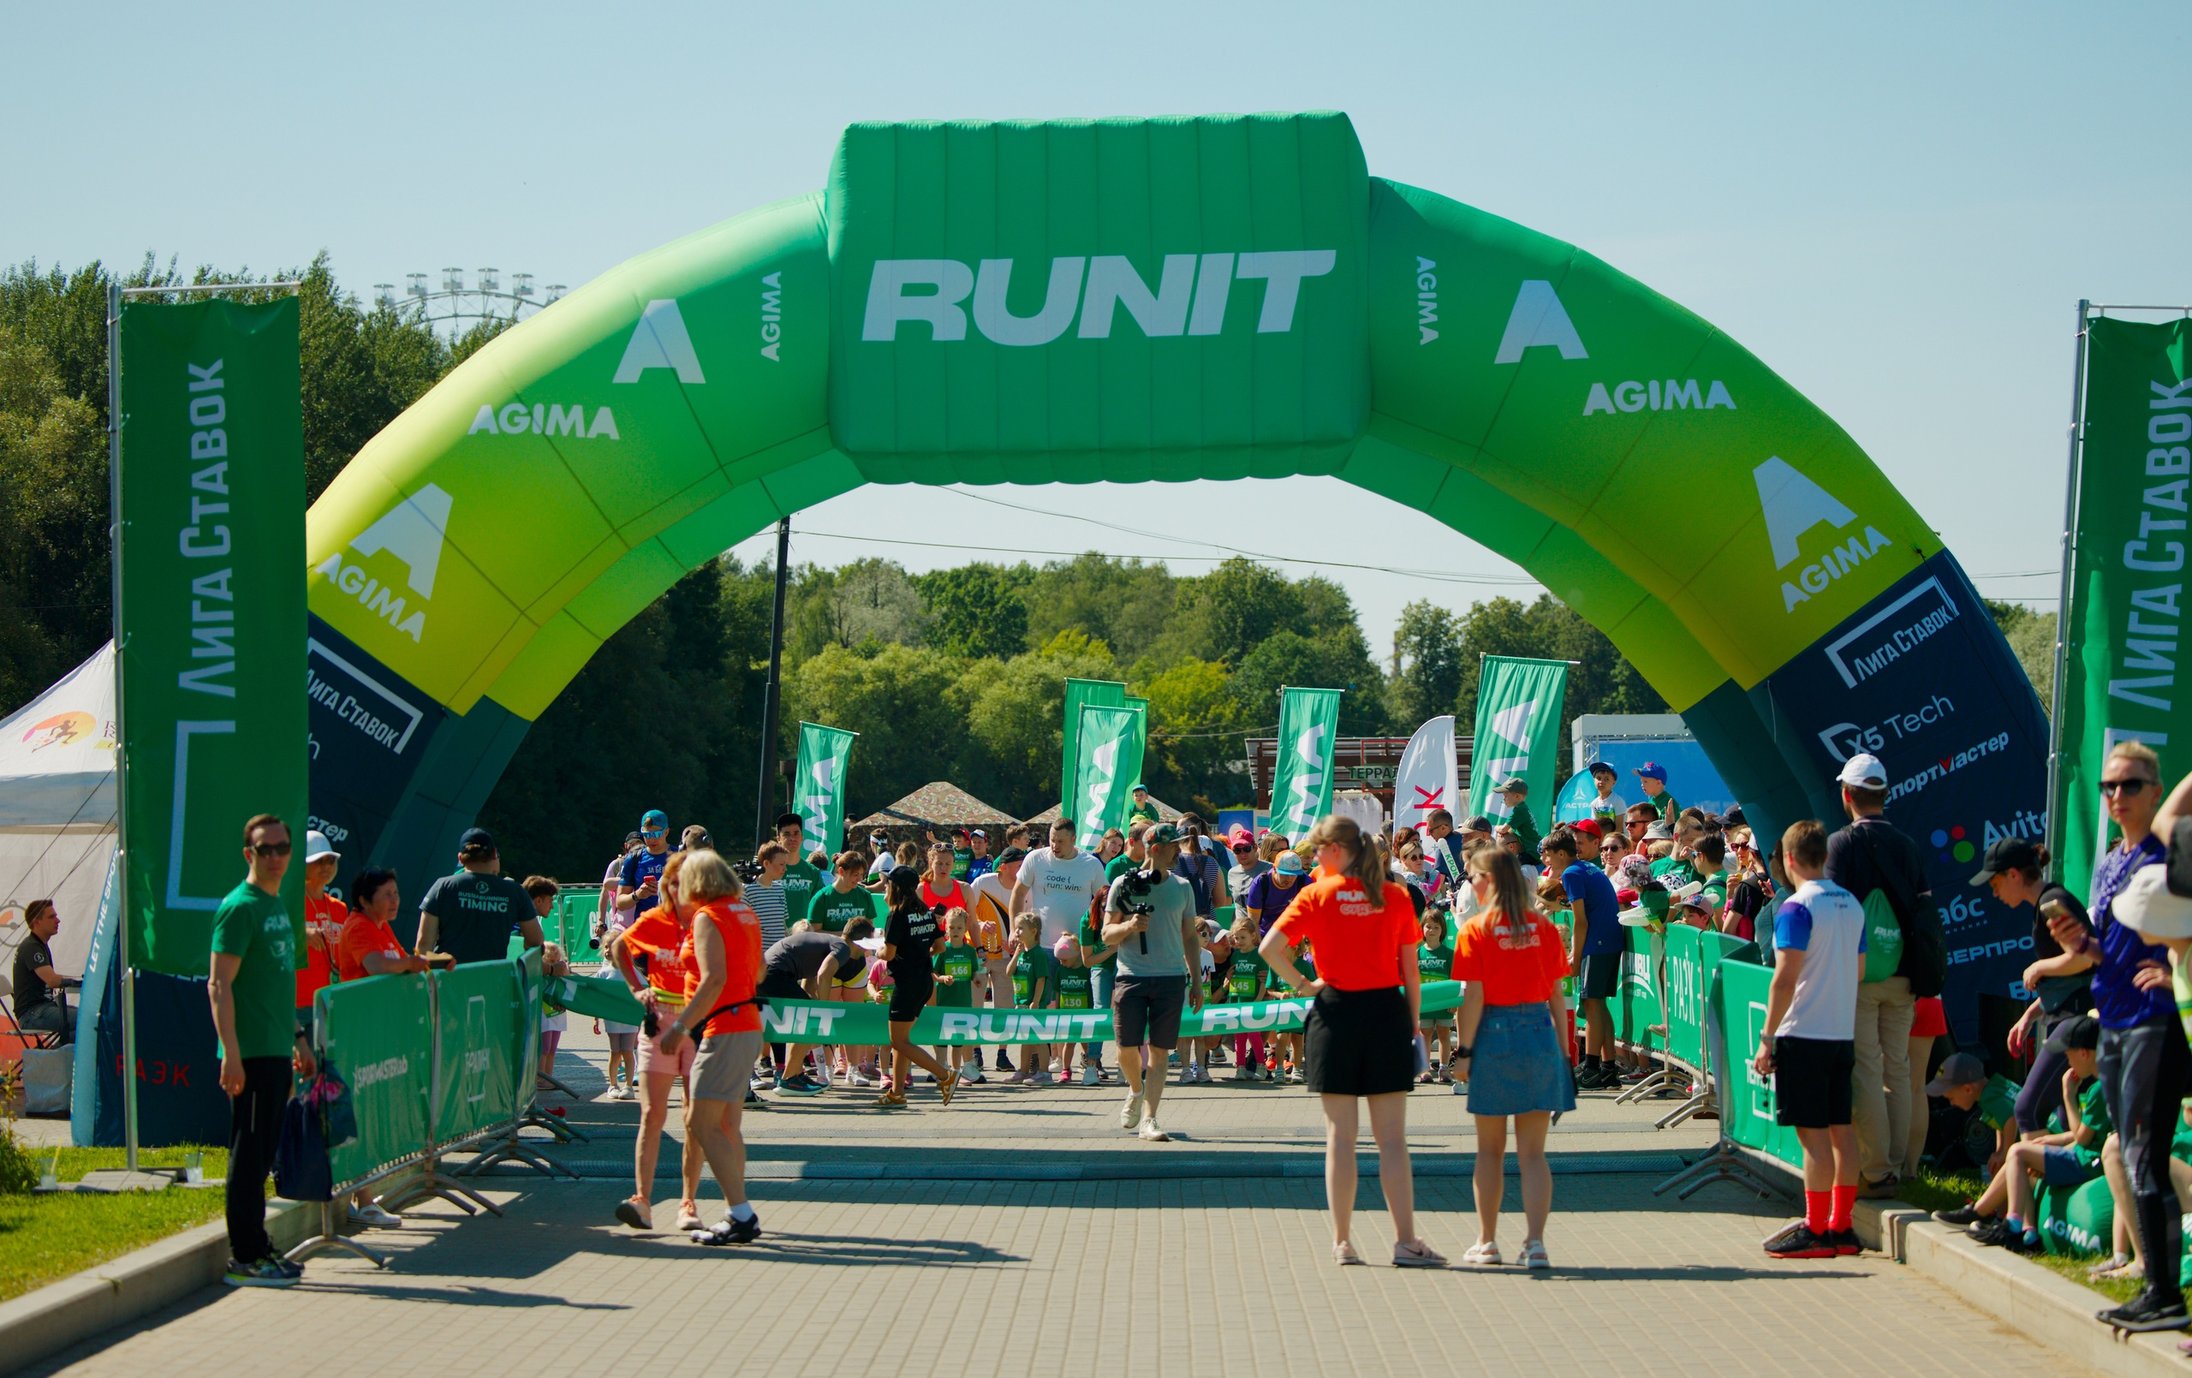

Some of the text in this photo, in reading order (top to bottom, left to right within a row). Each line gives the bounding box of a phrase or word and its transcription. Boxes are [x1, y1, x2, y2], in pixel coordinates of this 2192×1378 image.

[760, 271, 781, 362] AGIMA
[862, 249, 1336, 347] RUNIT
[1416, 255, 1439, 346] AGIMA
[1582, 379, 1736, 416] AGIMA
[467, 403, 620, 440] AGIMA
[1780, 525, 1893, 615] AGIMA
[315, 552, 426, 644] AGIMA
[1883, 694, 1955, 739] Tech
[1046, 874, 1066, 882] code
[458, 898, 508, 913] TIMING
[827, 908, 865, 918] RUNIT
[89, 937, 100, 973] LET
[96, 900, 108, 935] THE
[951, 966, 968, 976] 166
[761, 1004, 846, 1036] NIT
[1065, 998, 1082, 1007] 130
[1201, 999, 1315, 1032] RUN
[939, 1013, 1108, 1042] RUNIT
[2043, 1215, 2103, 1252] AGIMA
